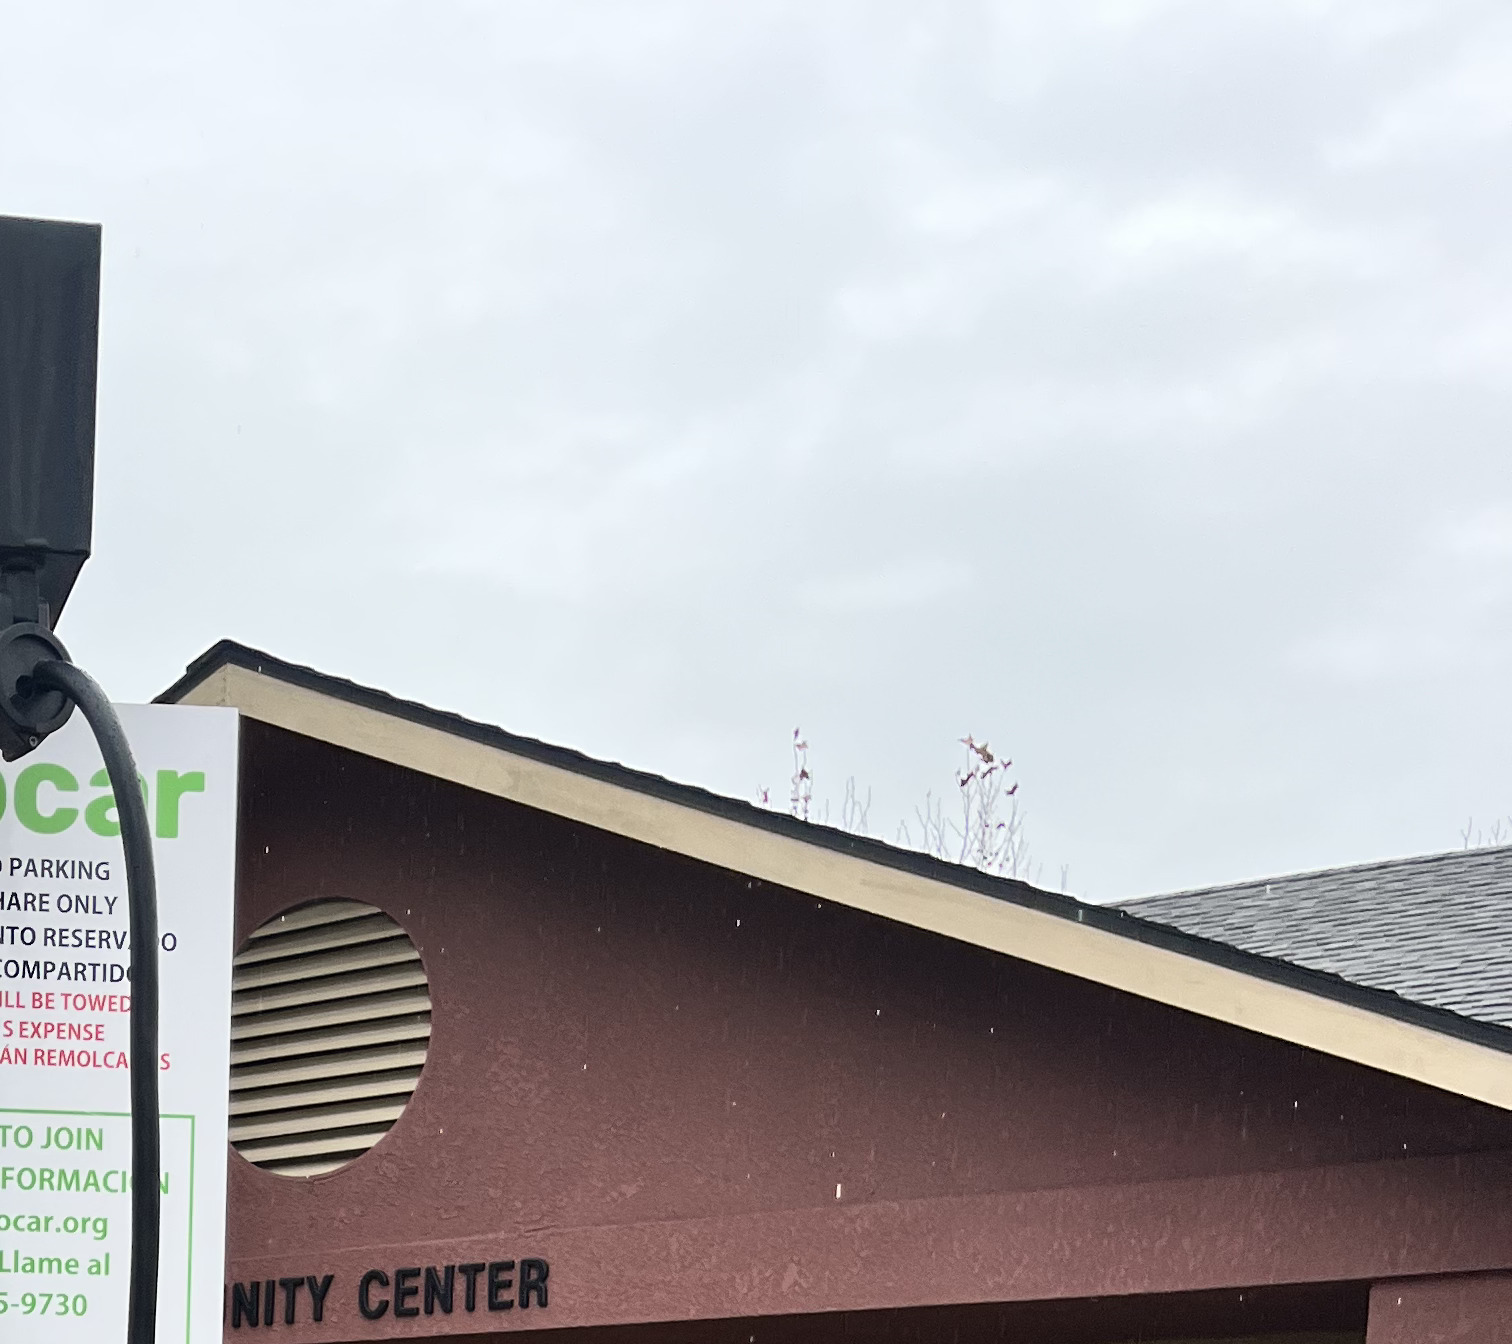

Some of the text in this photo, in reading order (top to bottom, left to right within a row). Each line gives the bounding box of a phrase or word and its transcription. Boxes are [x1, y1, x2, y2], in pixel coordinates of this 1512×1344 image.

[9, 857, 110, 880] PARKING
[56, 894, 118, 915] ONLY
[43, 927, 177, 951] RESERVO
[31, 991, 55, 1010] BE
[60, 992, 132, 1013] TOWED
[19, 1021, 105, 1042] EXPENSE
[34, 1048, 171, 1070] REMOLCAS
[40, 1126, 104, 1151] JOIN
[87, 1252, 111, 1276] al
[224, 1257, 550, 1329] NITY CENTER
